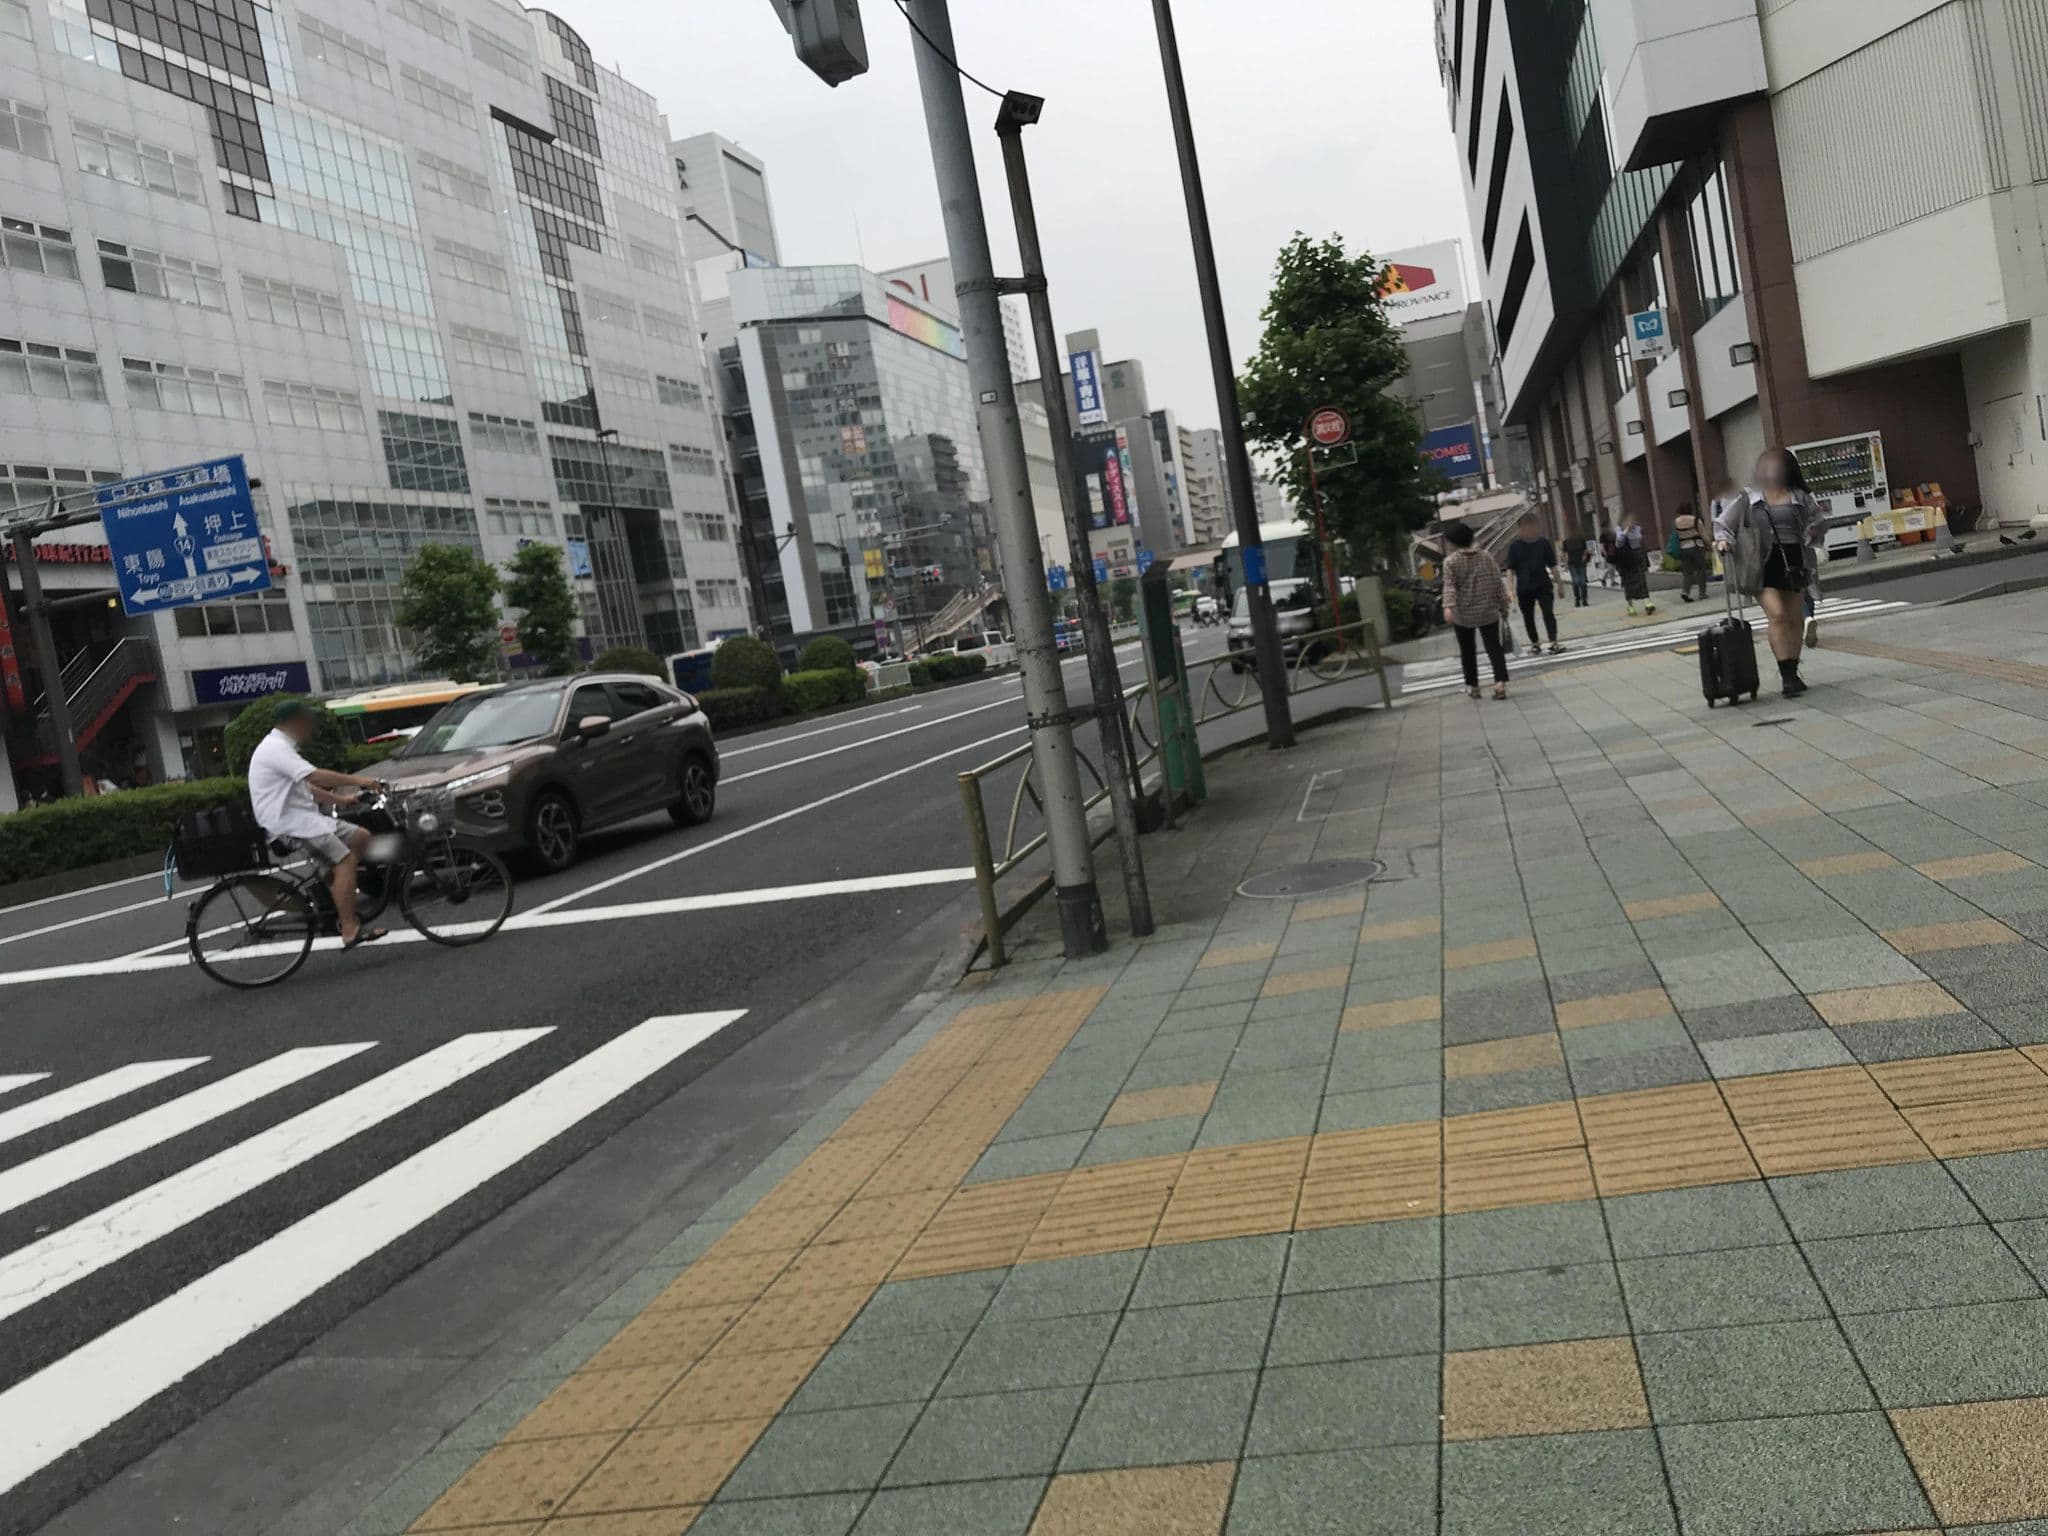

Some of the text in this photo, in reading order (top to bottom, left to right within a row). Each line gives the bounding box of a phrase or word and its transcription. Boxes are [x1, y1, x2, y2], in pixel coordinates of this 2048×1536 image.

[117, 499, 169, 519] Nihonbashi
[204, 509, 248, 535] 押上
[178, 539, 193, 552] 14
[123, 548, 166, 575] 東陽
[137, 573, 160, 585] Toyo
